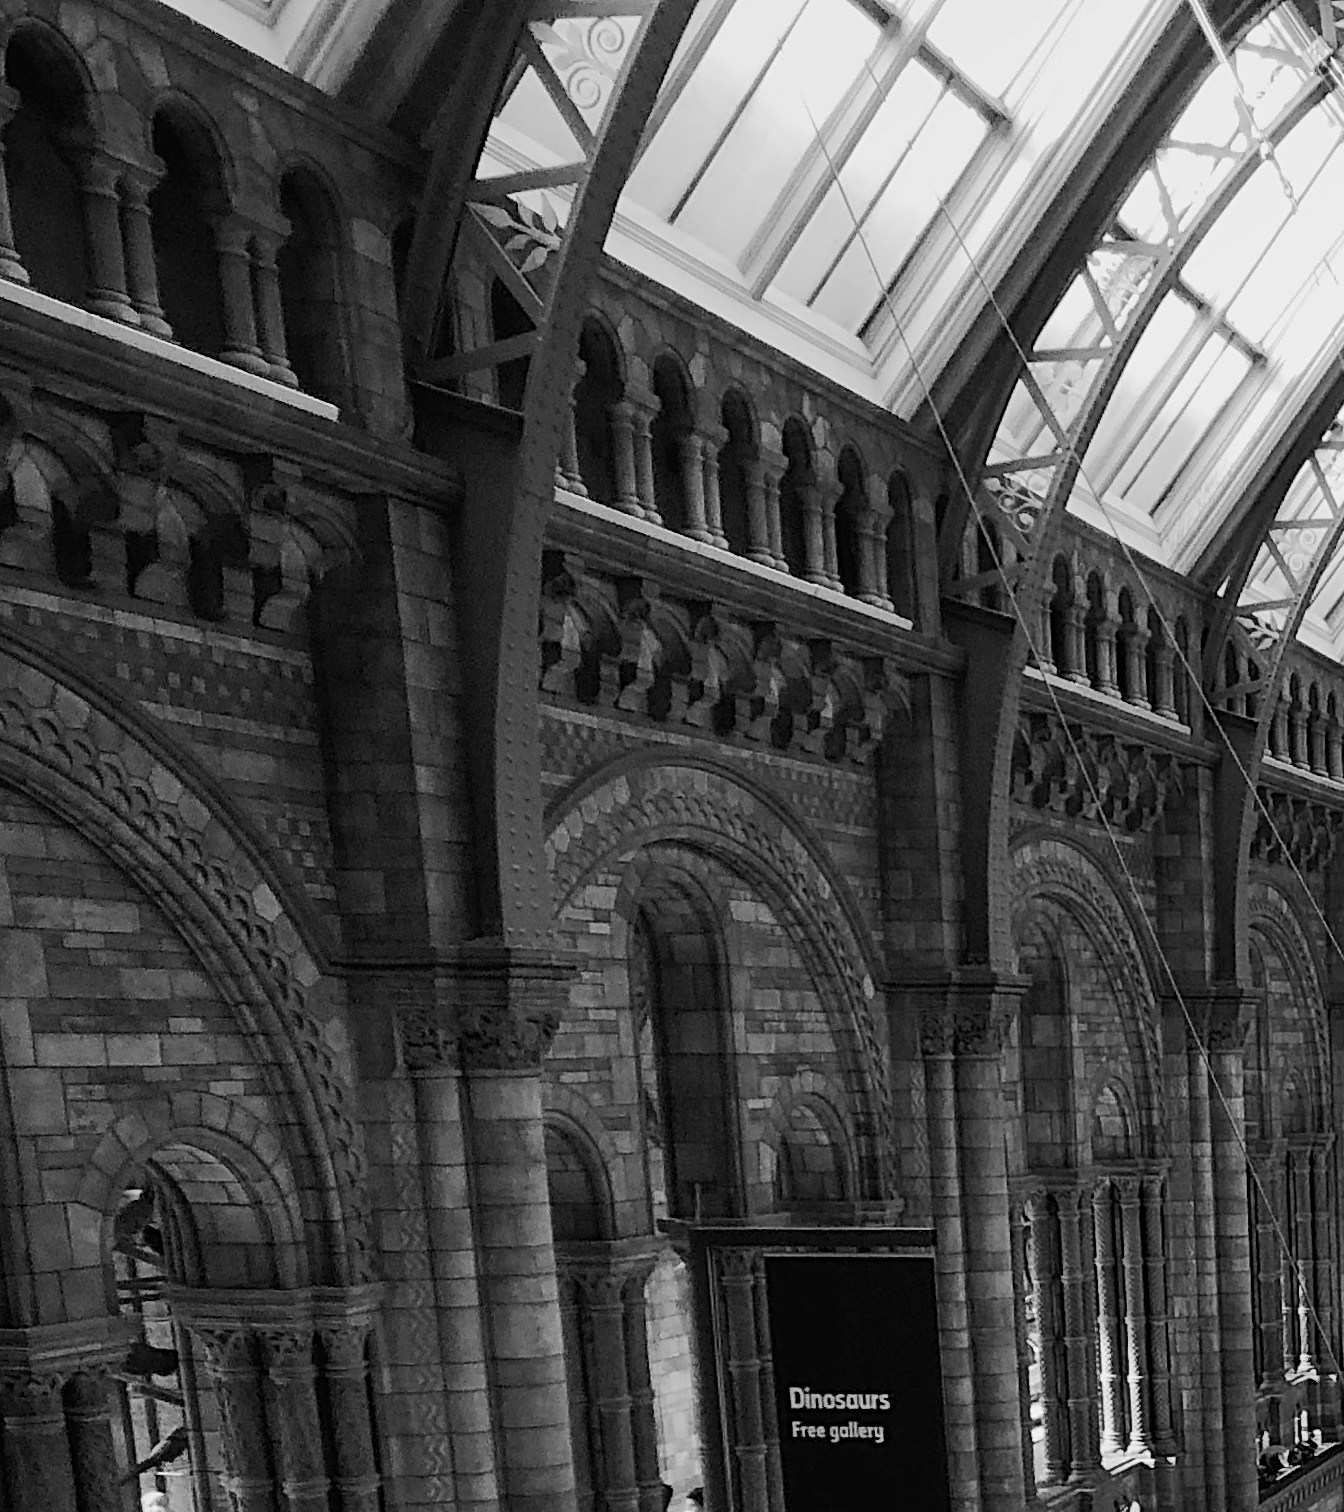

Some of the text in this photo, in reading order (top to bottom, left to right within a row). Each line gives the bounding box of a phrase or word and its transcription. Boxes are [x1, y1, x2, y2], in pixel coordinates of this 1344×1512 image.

[789, 1386, 891, 1410] Dinosaurs
[792, 1421, 885, 1443] Free gallery
